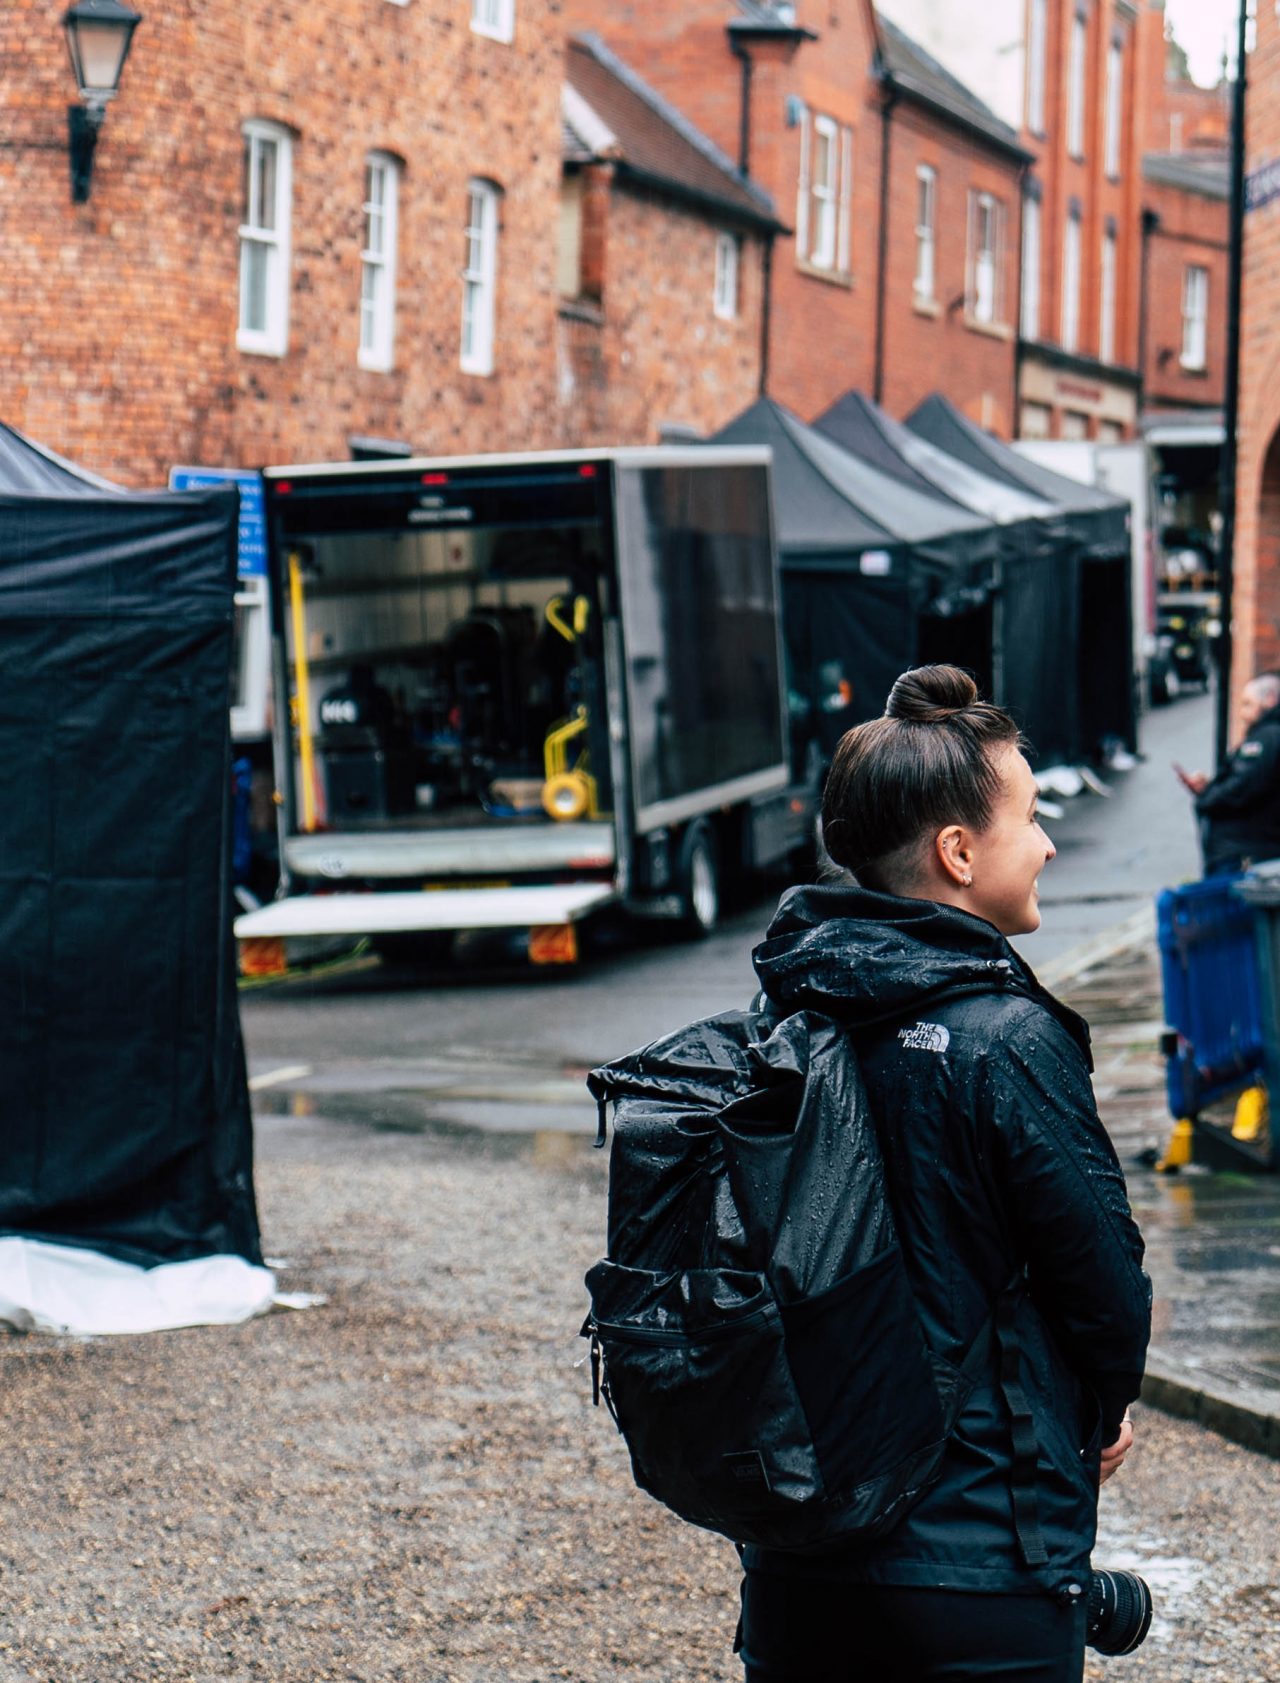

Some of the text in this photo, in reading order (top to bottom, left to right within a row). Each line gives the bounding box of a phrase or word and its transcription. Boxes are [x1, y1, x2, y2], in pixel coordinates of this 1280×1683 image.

[916, 1022, 936, 1031] THE
[897, 1029, 931, 1040] NORTH
[902, 1039, 928, 1049] FACE
